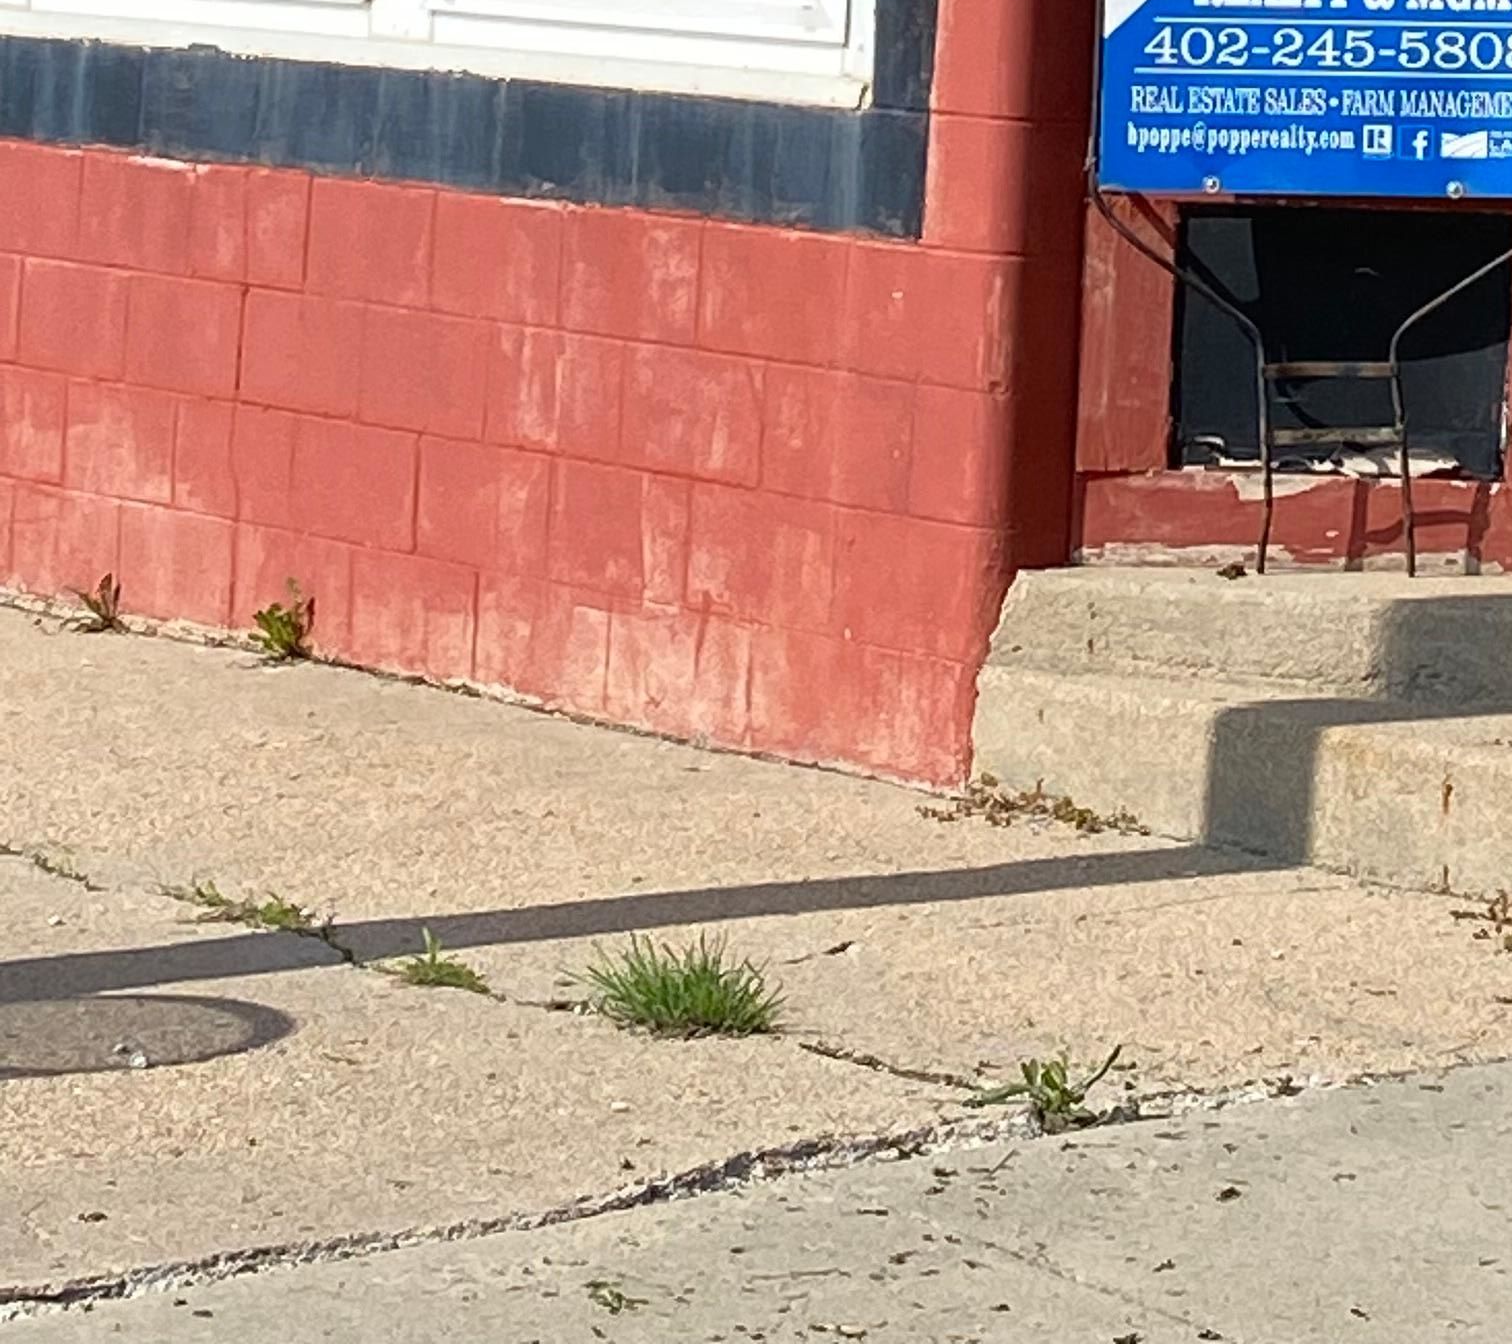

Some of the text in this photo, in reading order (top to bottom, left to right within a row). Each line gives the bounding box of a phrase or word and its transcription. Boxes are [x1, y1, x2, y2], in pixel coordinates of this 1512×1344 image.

[1130, 85, 1184, 113] REAL
[1187, 86, 1261, 115] ESTATE
[1264, 87, 1327, 116] SALES
[1340, 89, 1395, 117] FARM
[1127, 121, 1356, 156] bpoppe@popperealty.com
